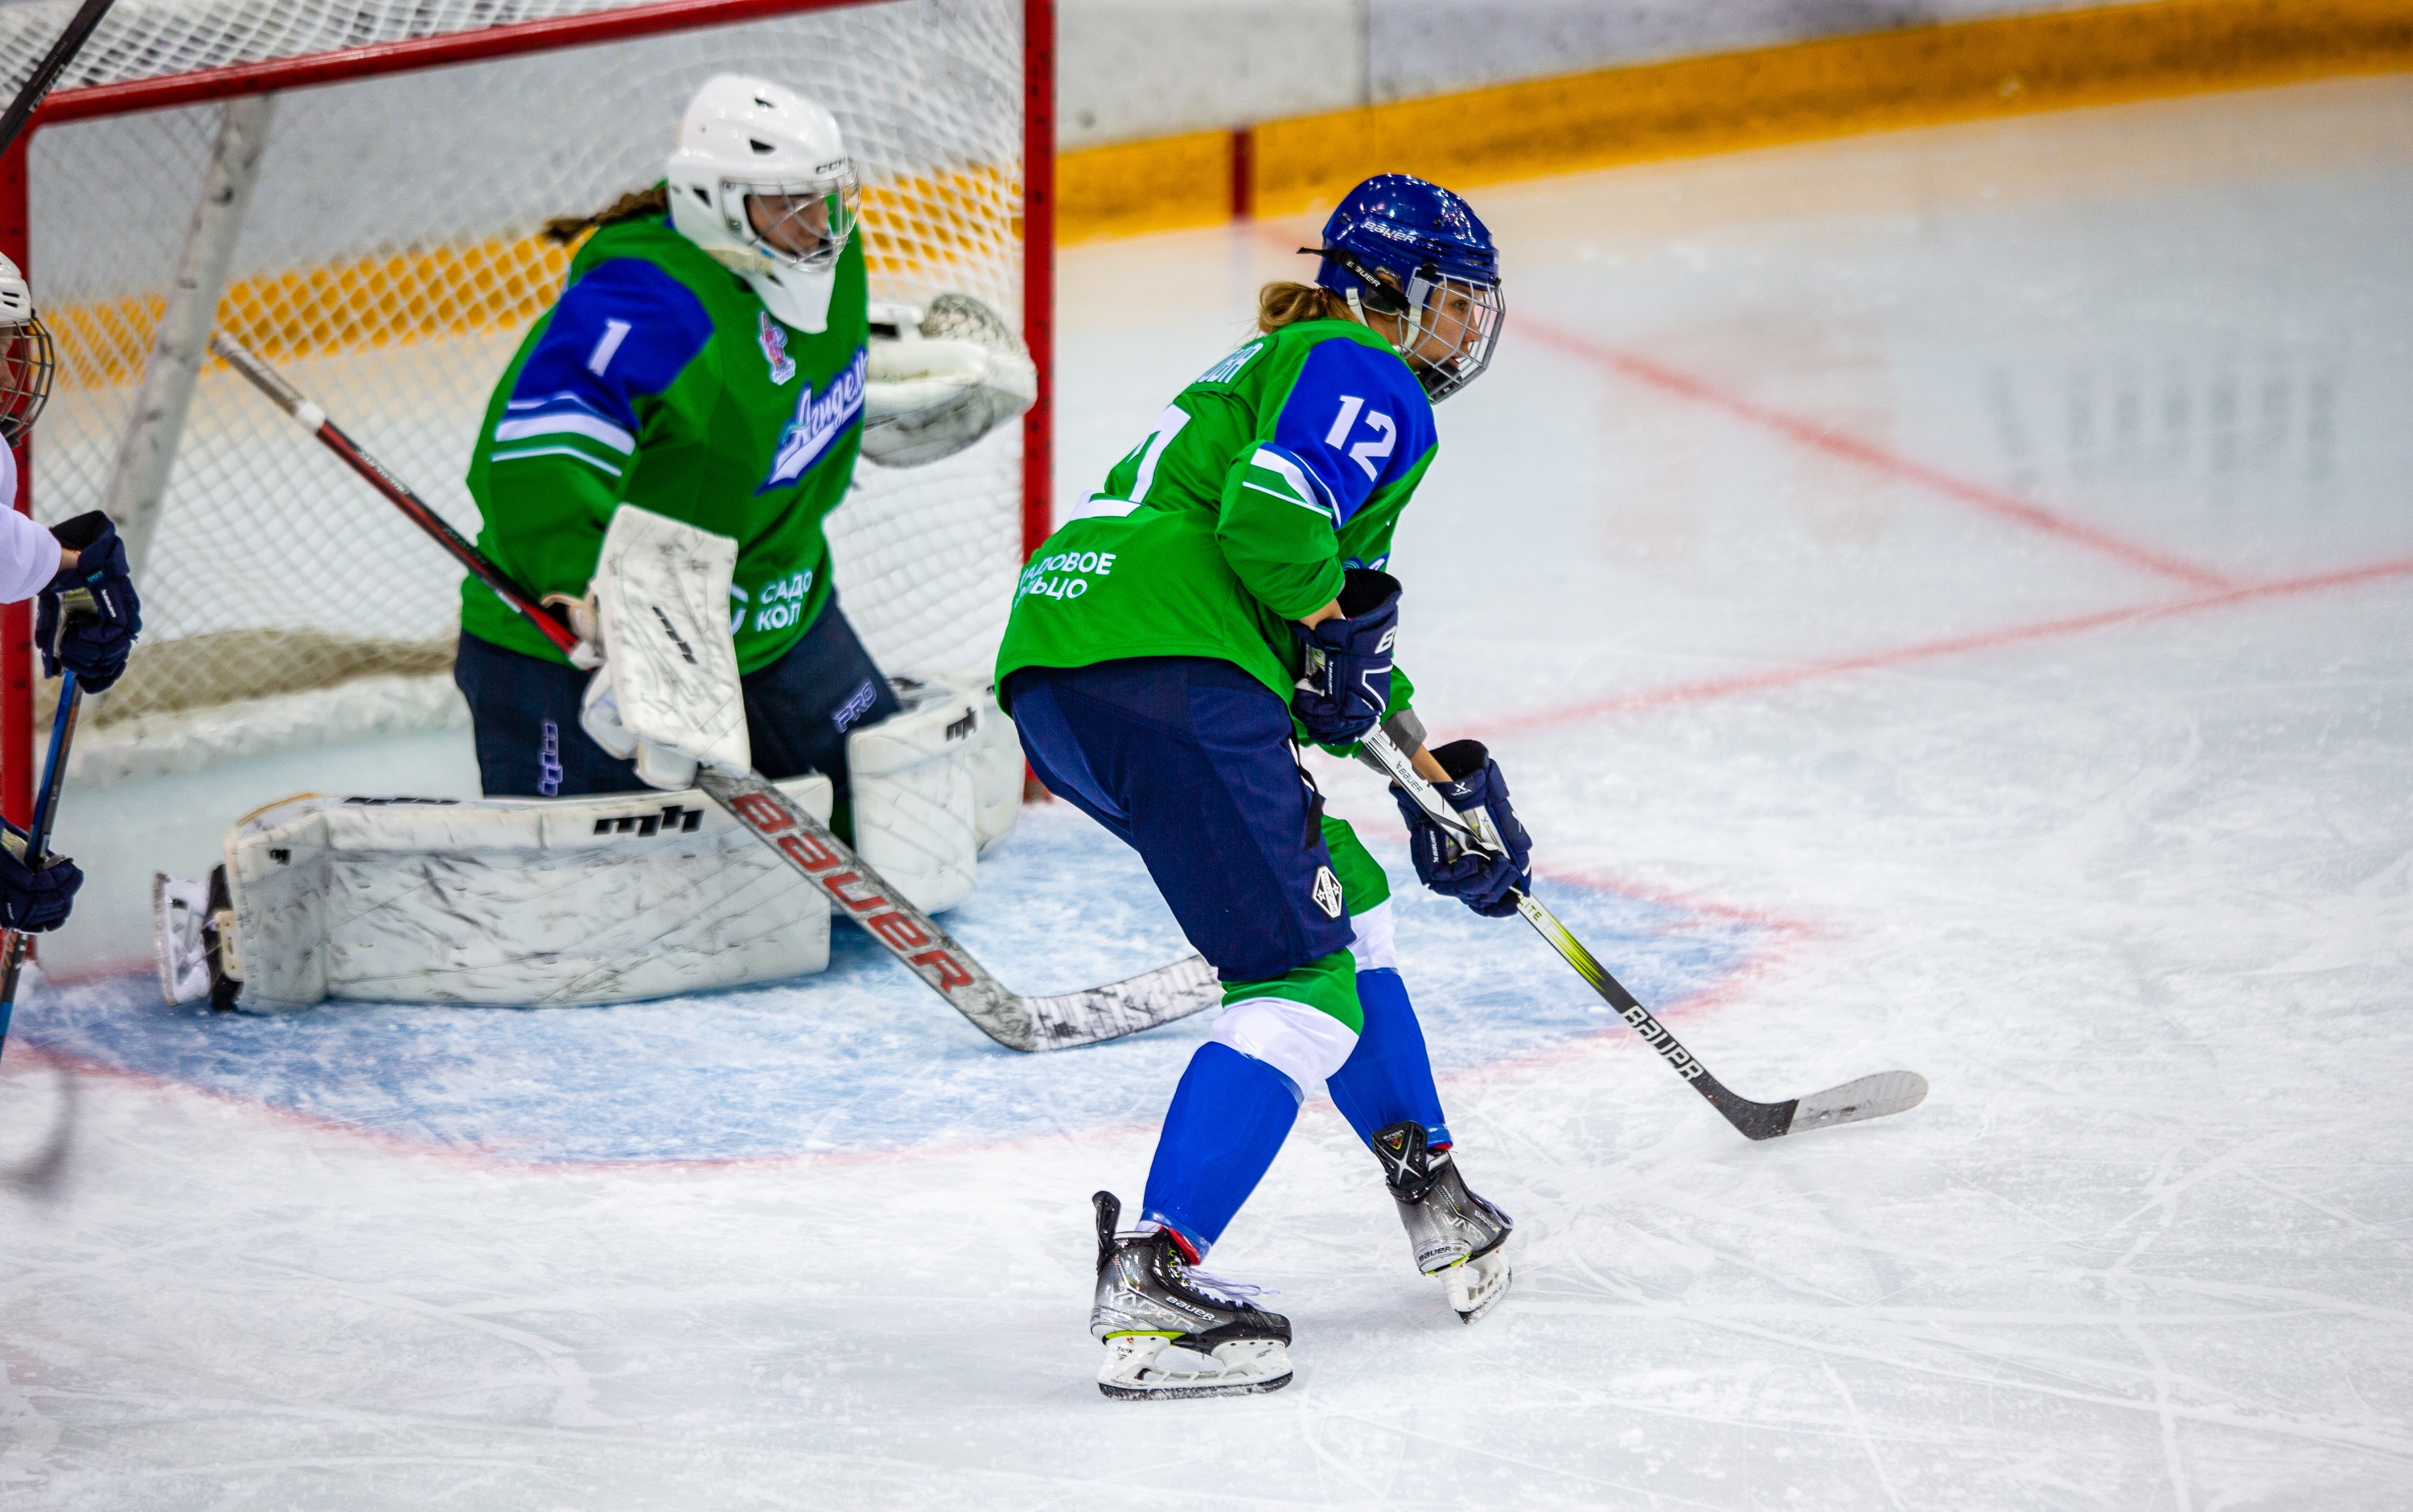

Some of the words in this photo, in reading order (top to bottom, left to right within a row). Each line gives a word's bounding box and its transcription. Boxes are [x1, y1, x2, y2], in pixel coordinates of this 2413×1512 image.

[1364, 220, 1417, 244] BAUER
[588, 320, 632, 376] 1
[1324, 395, 1397, 482] 12
[1398, 768, 1423, 793] BAUER
[731, 792, 974, 992] BAUER
[1519, 894, 1543, 922] LITE
[1621, 1005, 1704, 1083] BAUER
[1166, 1296, 1215, 1321] BAUER
